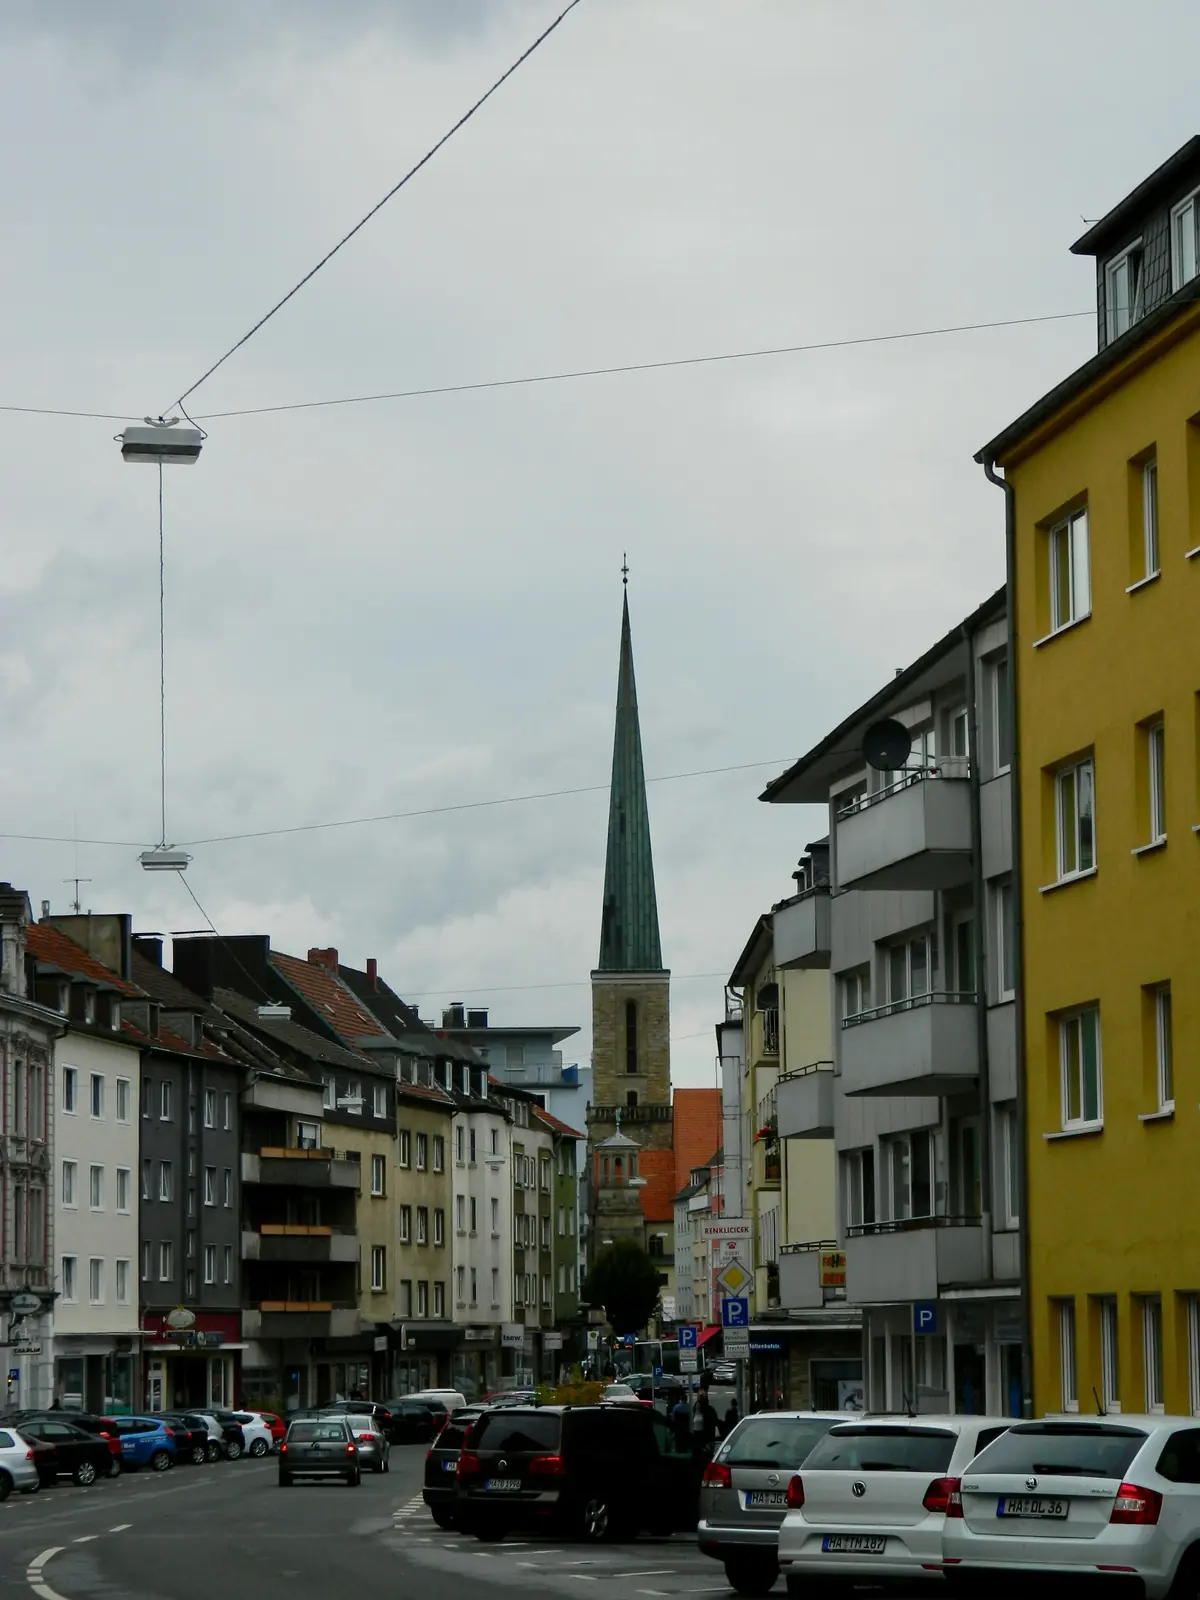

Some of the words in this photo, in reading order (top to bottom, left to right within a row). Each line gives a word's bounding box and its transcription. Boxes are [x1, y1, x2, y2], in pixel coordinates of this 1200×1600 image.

[728, 1302, 742, 1324] P
[920, 1310, 932, 1327] P
[682, 1329, 693, 1346] P
[655, 1367, 661, 1375] P
[752, 1492, 764, 1503] HA
[1008, 1499, 1023, 1513] HA
[1030, 1500, 1045, 1513] DL
[1049, 1501, 1062, 1514] 36
[829, 1537, 842, 1548] HA
